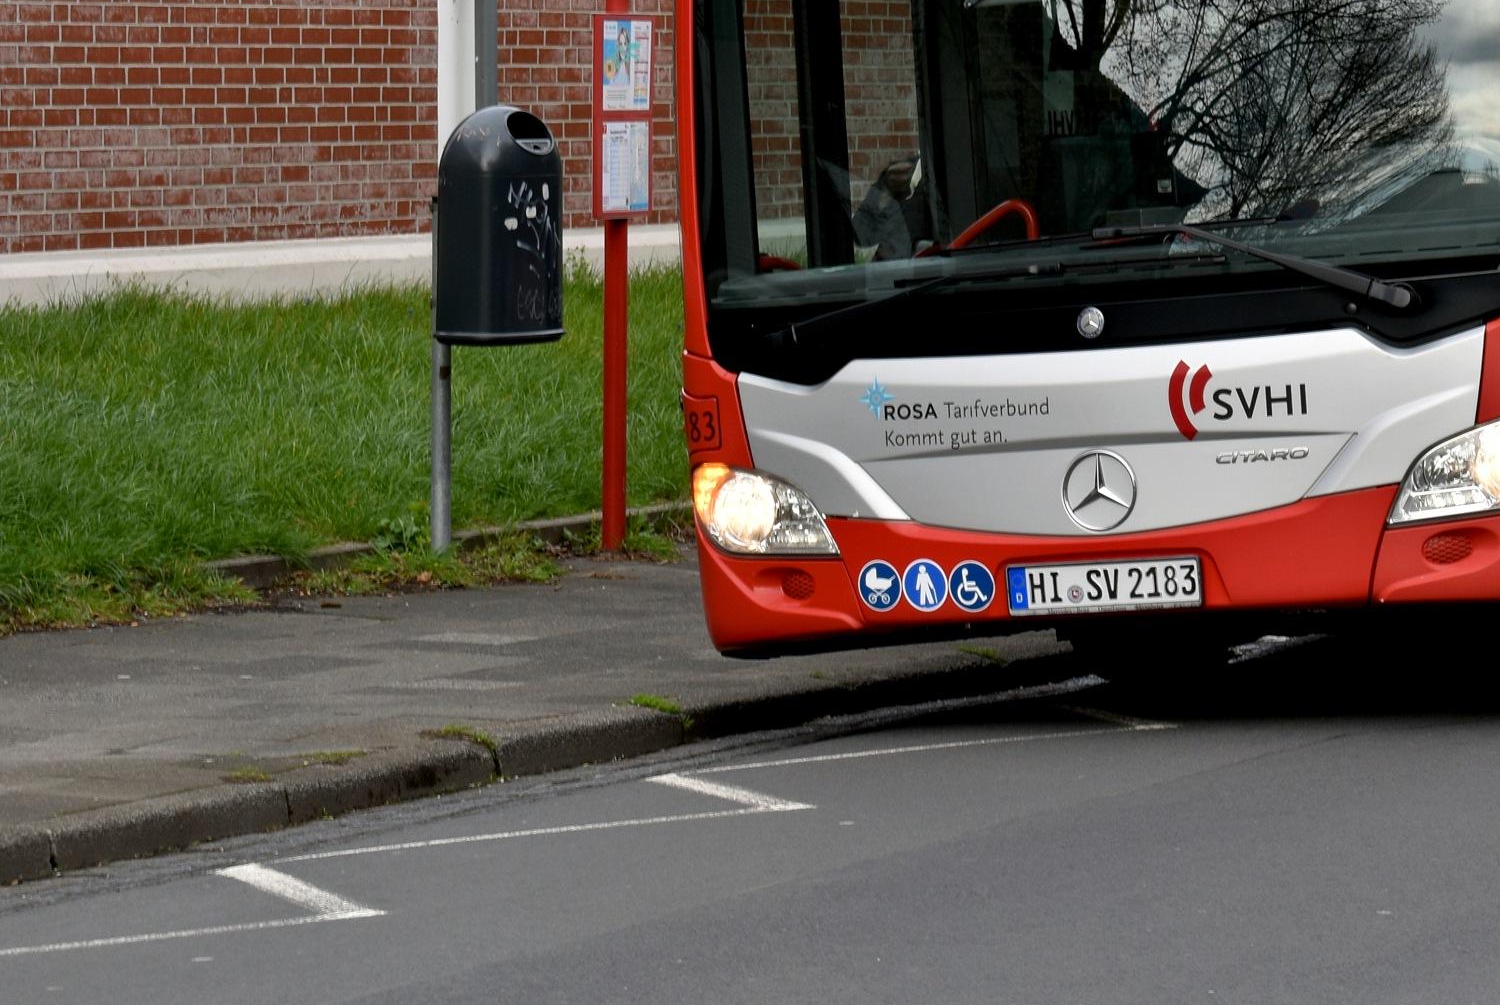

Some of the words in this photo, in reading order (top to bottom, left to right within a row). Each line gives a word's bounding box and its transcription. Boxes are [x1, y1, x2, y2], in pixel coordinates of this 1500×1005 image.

[884, 403, 938, 421] ROSA
[943, 396, 1050, 419] Tarifverbund
[1212, 383, 1308, 421] SVHI
[885, 430, 944, 447] Kommt
[950, 429, 977, 450] gut
[983, 430, 1008, 444] an.
[1215, 446, 1310, 465] CITARO
[1015, 592, 1023, 604] D
[1028, 572, 1063, 604] HI
[1086, 568, 1119, 601] SV
[1127, 564, 1197, 598] 2183
